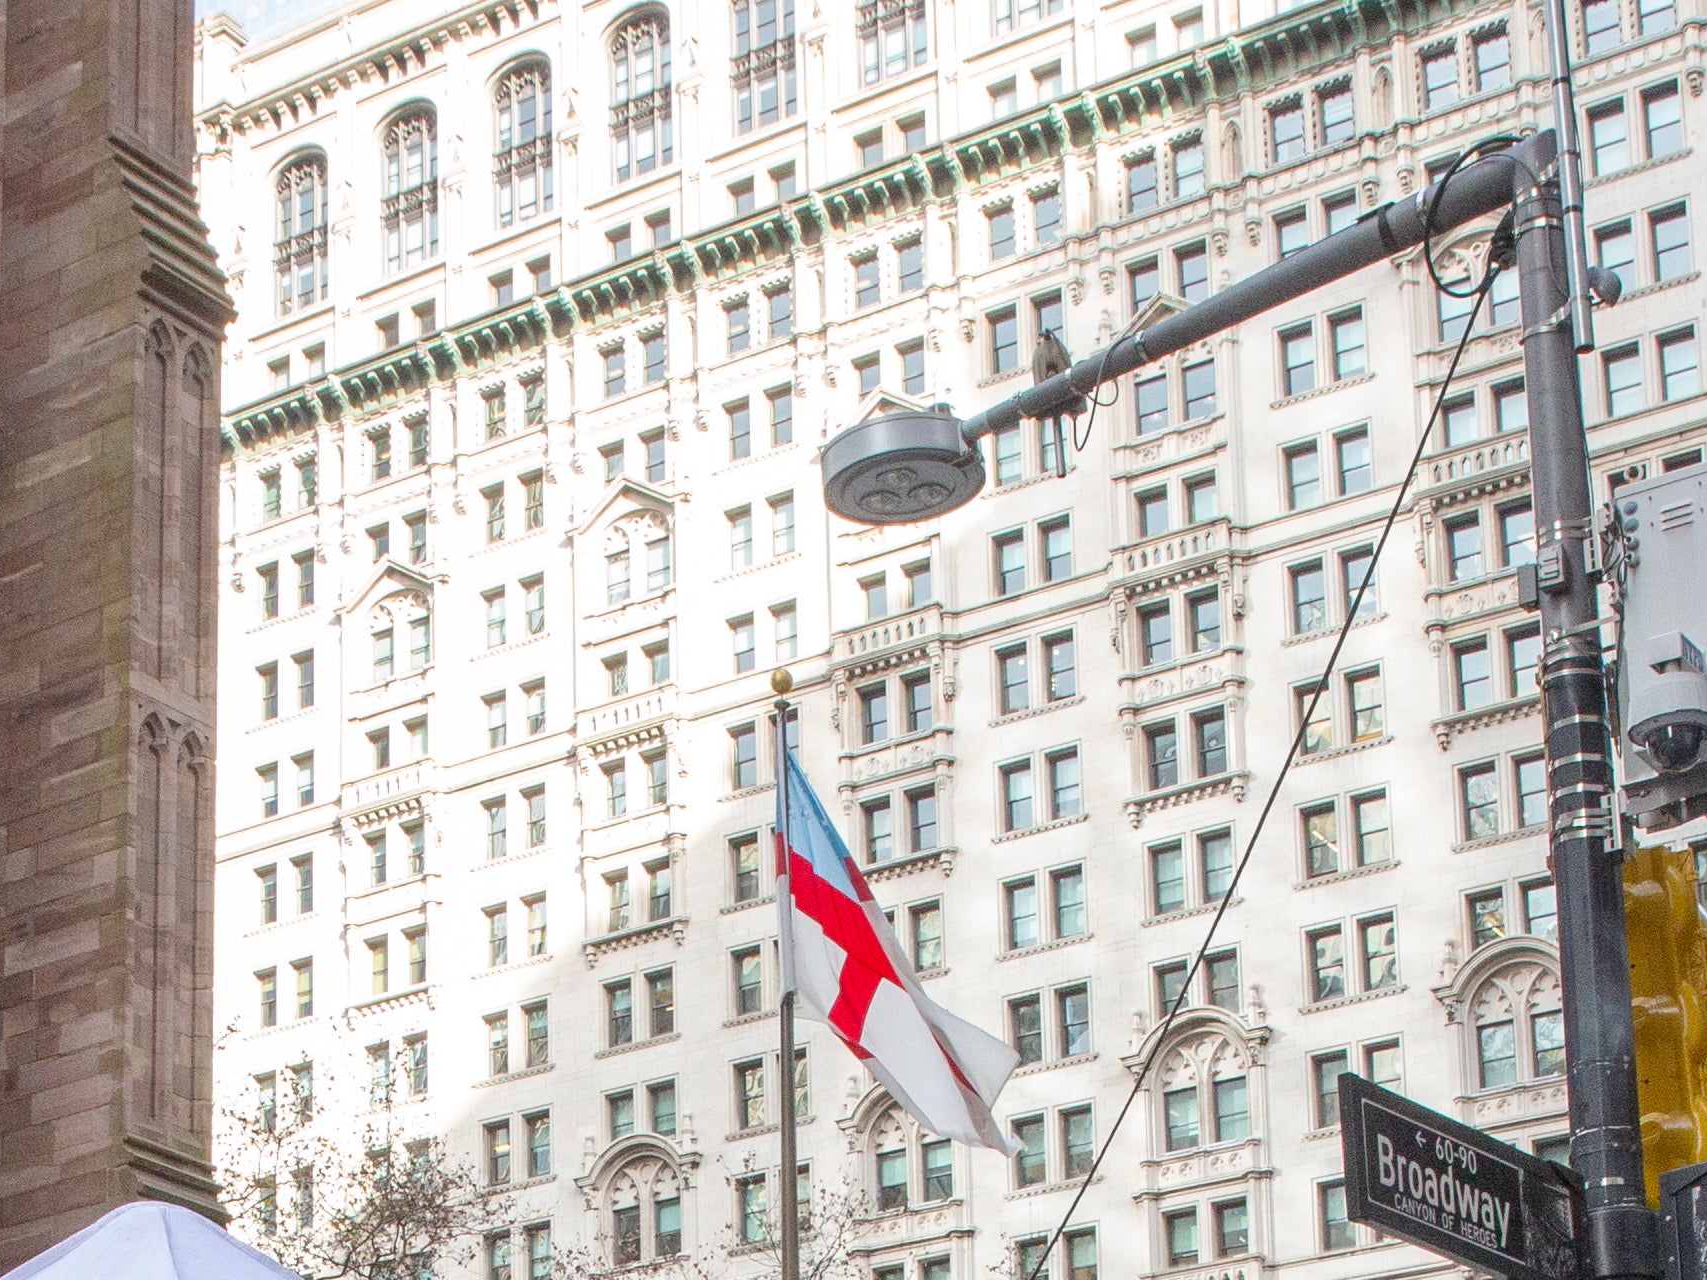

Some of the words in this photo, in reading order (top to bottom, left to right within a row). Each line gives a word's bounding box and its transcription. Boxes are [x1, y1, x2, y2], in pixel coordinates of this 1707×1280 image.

[1435, 1137, 1477, 1174] 60-90
[1377, 1133, 1510, 1248] Broadway
[1394, 1193, 1437, 1224] CANYON
[1442, 1215, 1455, 1232] OF
[1460, 1220, 1498, 1249] HEROES
